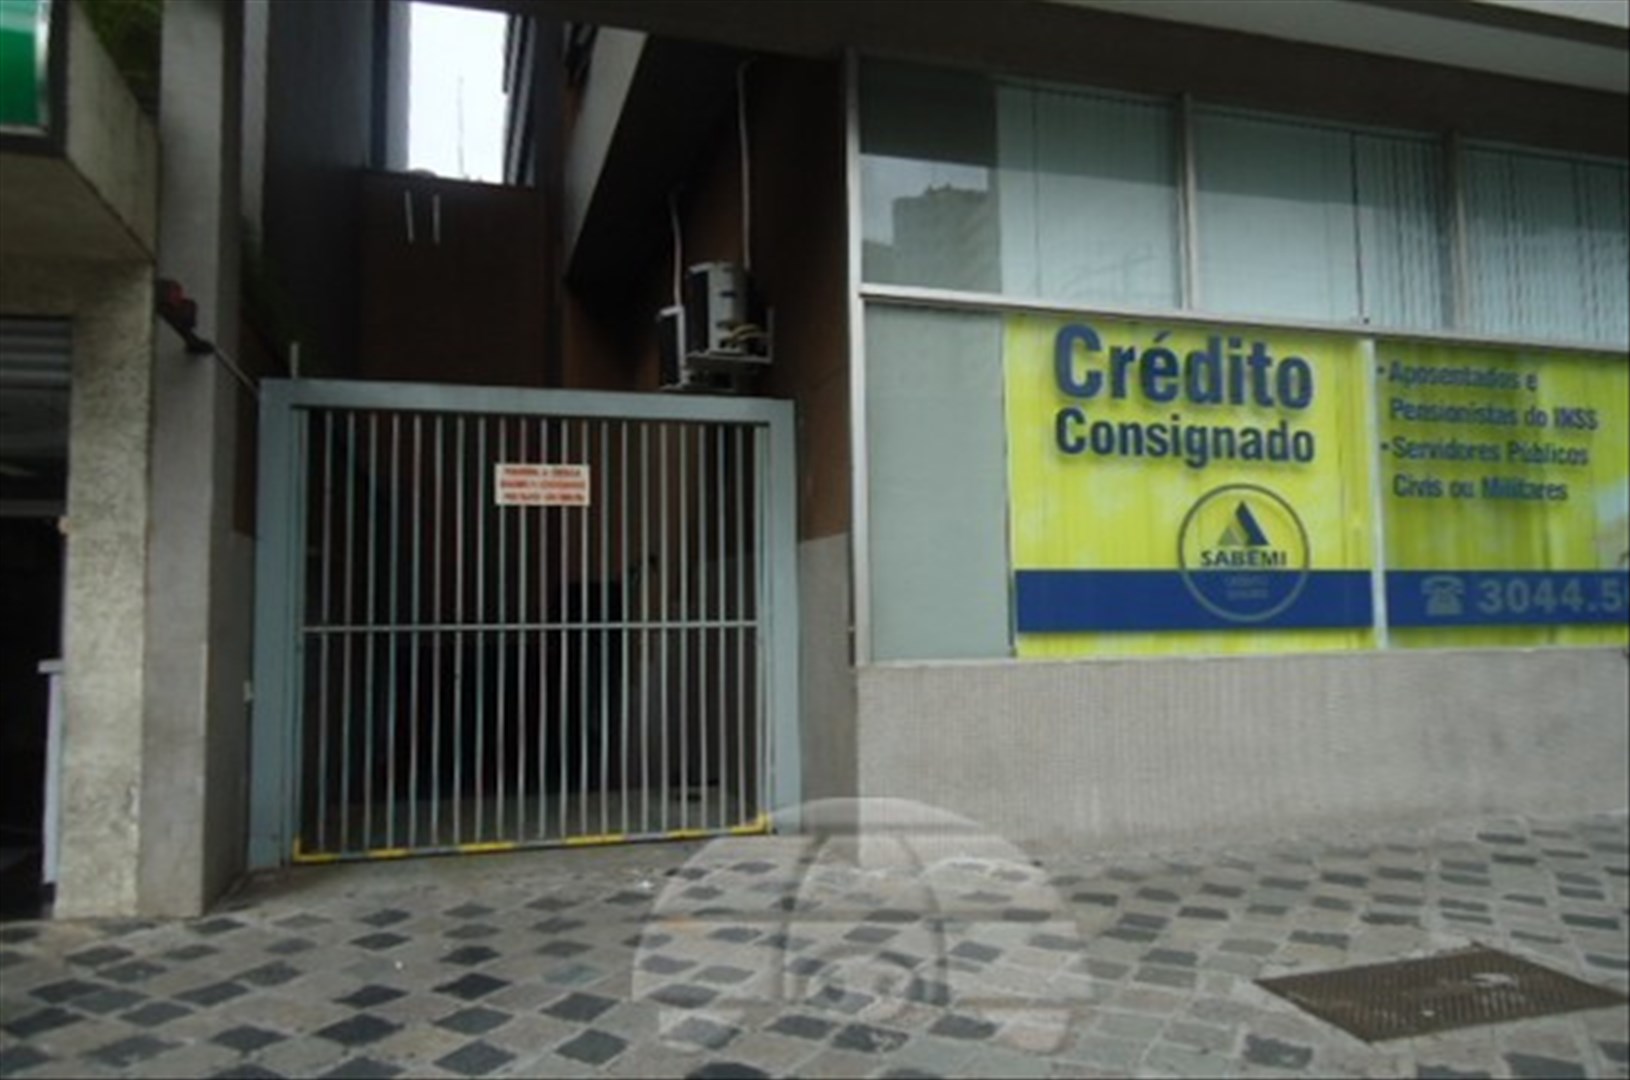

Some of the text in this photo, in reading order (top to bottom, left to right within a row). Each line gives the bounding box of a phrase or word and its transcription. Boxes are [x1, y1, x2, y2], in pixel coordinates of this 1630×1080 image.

[1054, 323, 1314, 410] Crédito
[1389, 362, 1538, 391] Aposentados e
[1390, 398, 1599, 430] Pensionistas do INSS
[1054, 407, 1315, 469] Consignado
[1392, 437, 1590, 465] Servidores Públicos
[1393, 474, 1568, 501] Civis ou Militares
[1200, 550, 1288, 567] SABEMI
